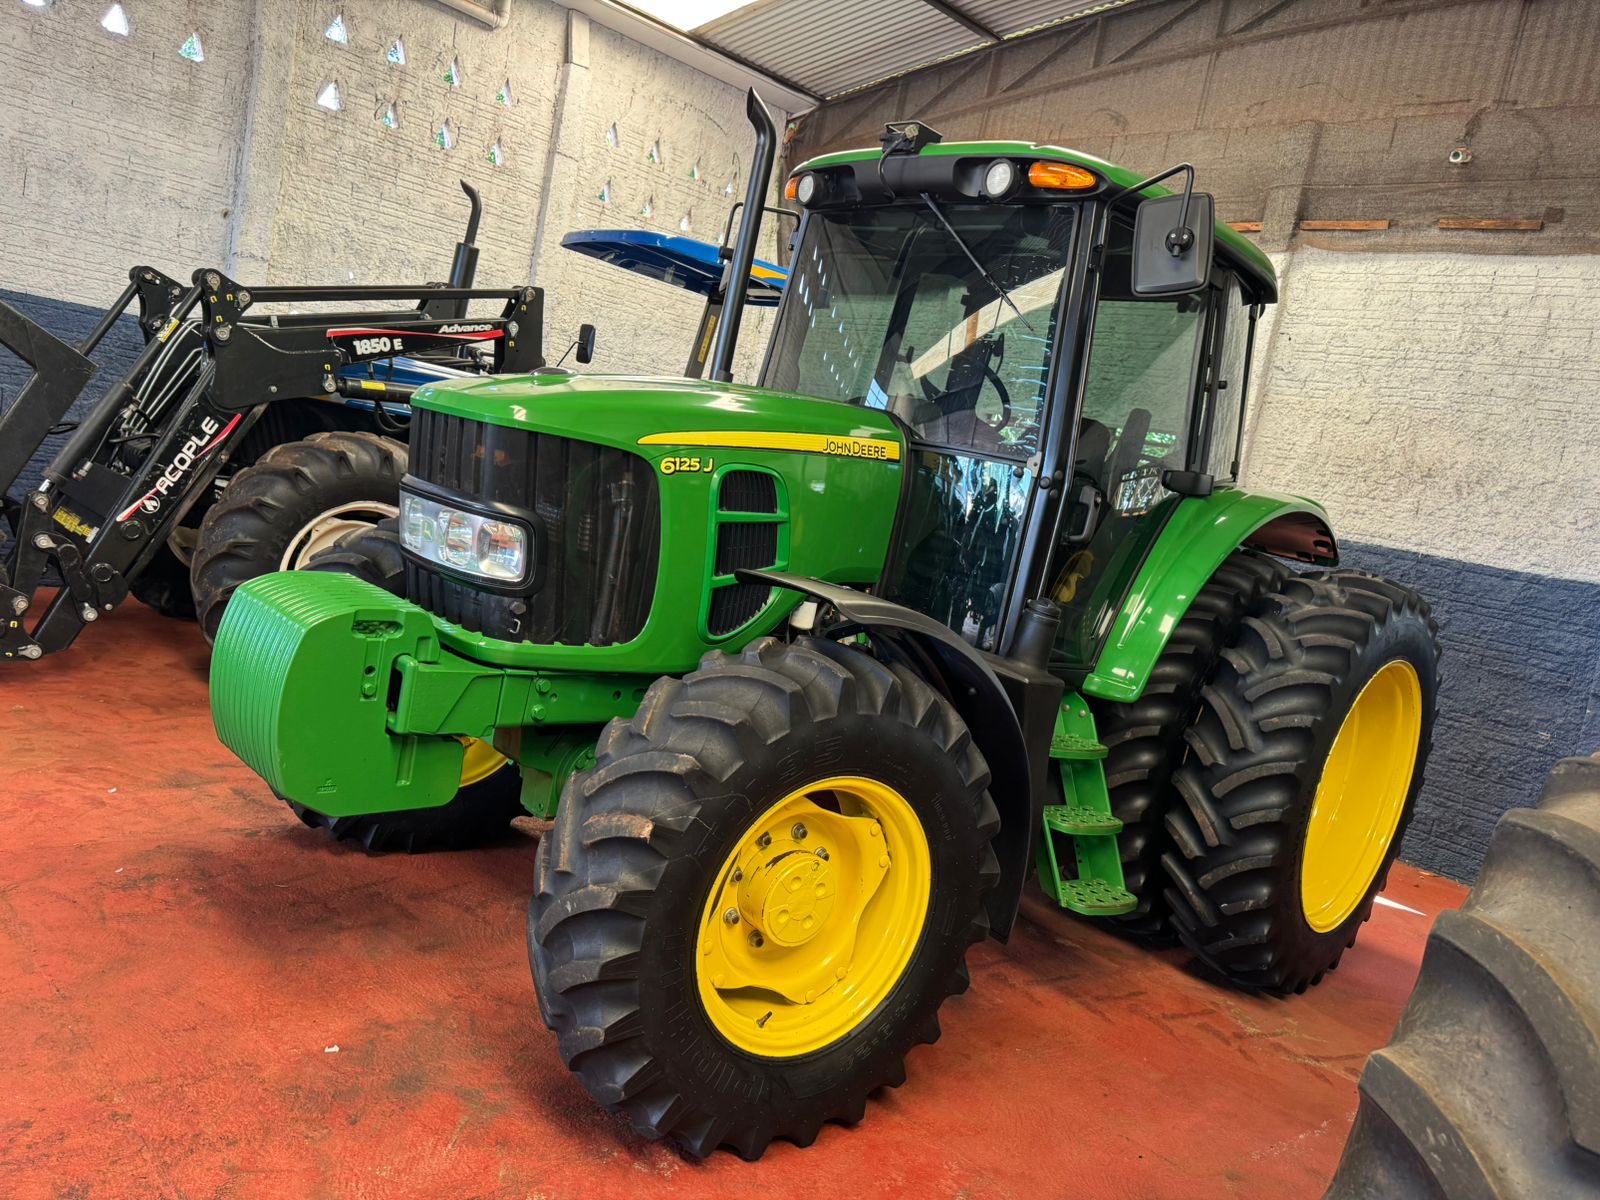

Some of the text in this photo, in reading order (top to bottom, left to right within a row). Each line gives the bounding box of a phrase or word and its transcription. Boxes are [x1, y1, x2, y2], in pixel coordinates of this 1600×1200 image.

[438, 323, 493, 334] Advance
[352, 337, 404, 356] 1850 E
[155, 416, 219, 495] ACOPLE
[659, 457, 715, 475] 6125 J
